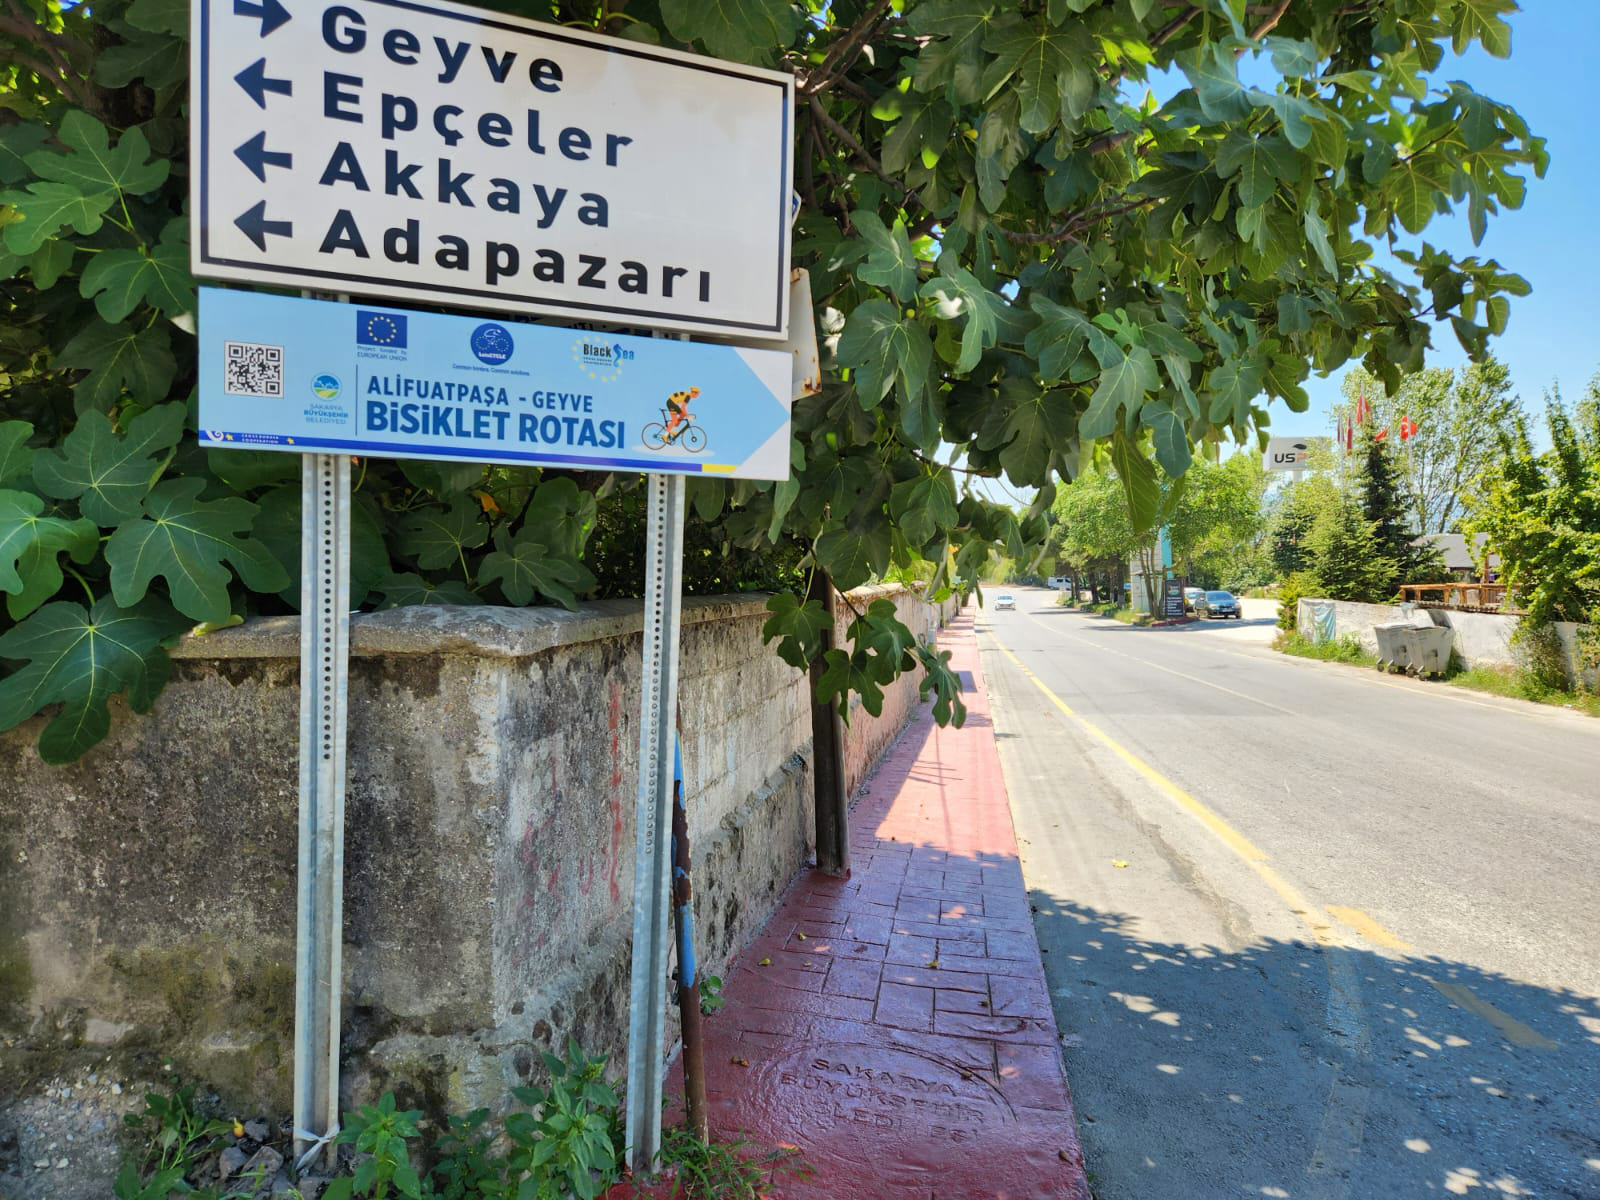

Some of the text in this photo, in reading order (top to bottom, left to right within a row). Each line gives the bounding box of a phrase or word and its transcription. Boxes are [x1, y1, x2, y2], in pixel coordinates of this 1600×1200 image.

[320, 5, 564, 94] Geyve
[322, 70, 633, 167] Epçeler
[318, 141, 611, 229] Akkaya
[318, 208, 711, 302] Adapazarı
[583, 343, 612, 358] Black
[367, 374, 509, 407] ALİFUATPAŞA
[532, 390, 593, 413] GEYVE
[518, 413, 625, 449] ROTASI
[812, 1058, 958, 1098] SAKARYA
